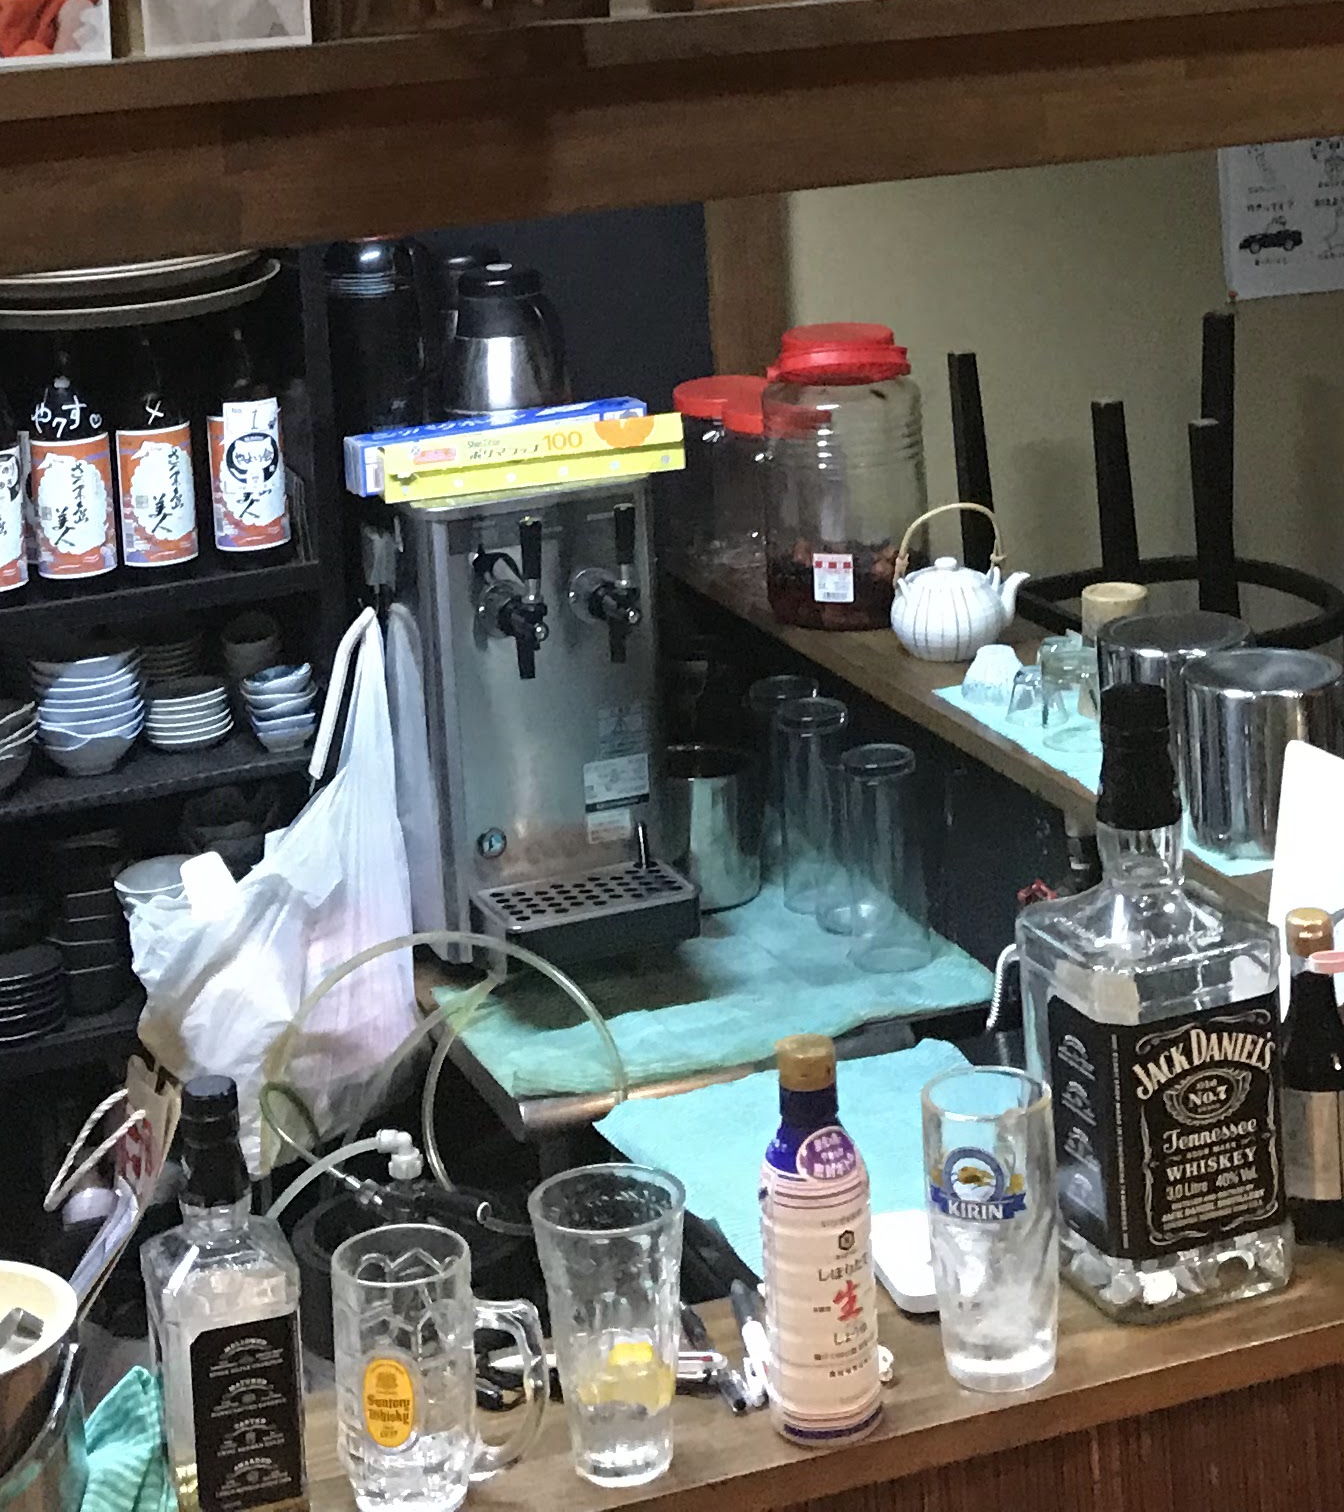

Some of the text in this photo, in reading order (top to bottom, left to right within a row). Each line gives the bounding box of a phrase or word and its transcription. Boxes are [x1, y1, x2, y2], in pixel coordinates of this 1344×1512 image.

[543, 430, 583, 453] 100
[1131, 1042, 1191, 1101] JACK
[1162, 1118, 1257, 1154] Tennessee
[1165, 1146, 1257, 1182] WHISKEY
[947, 1199, 1004, 1220] KIRIN
[832, 1279, 864, 1323] 生
[366, 1394, 410, 1412] Suntory
